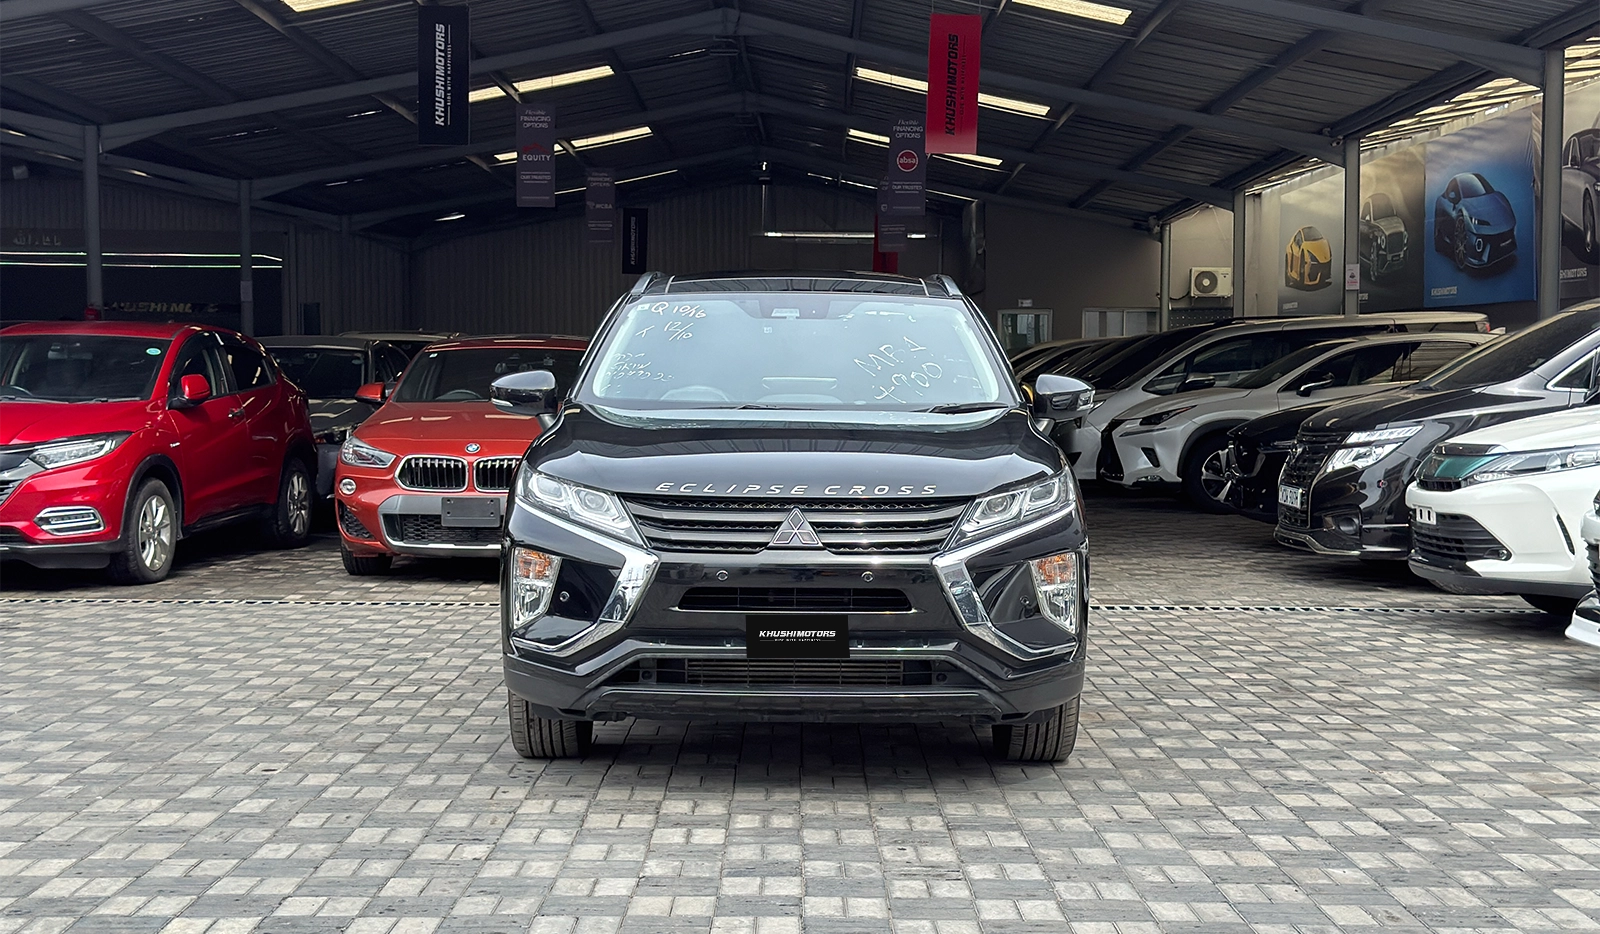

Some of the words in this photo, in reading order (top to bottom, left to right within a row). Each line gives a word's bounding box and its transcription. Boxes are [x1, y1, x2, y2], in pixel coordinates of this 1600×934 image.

[435, 23, 446, 126] KHUSHIMOTORS
[945, 33, 959, 136] KHUSHIMOTORS
[651, 301, 670, 316] Q
[655, 482, 808, 495] ECLIPSE
[823, 484, 937, 495] CROSS
